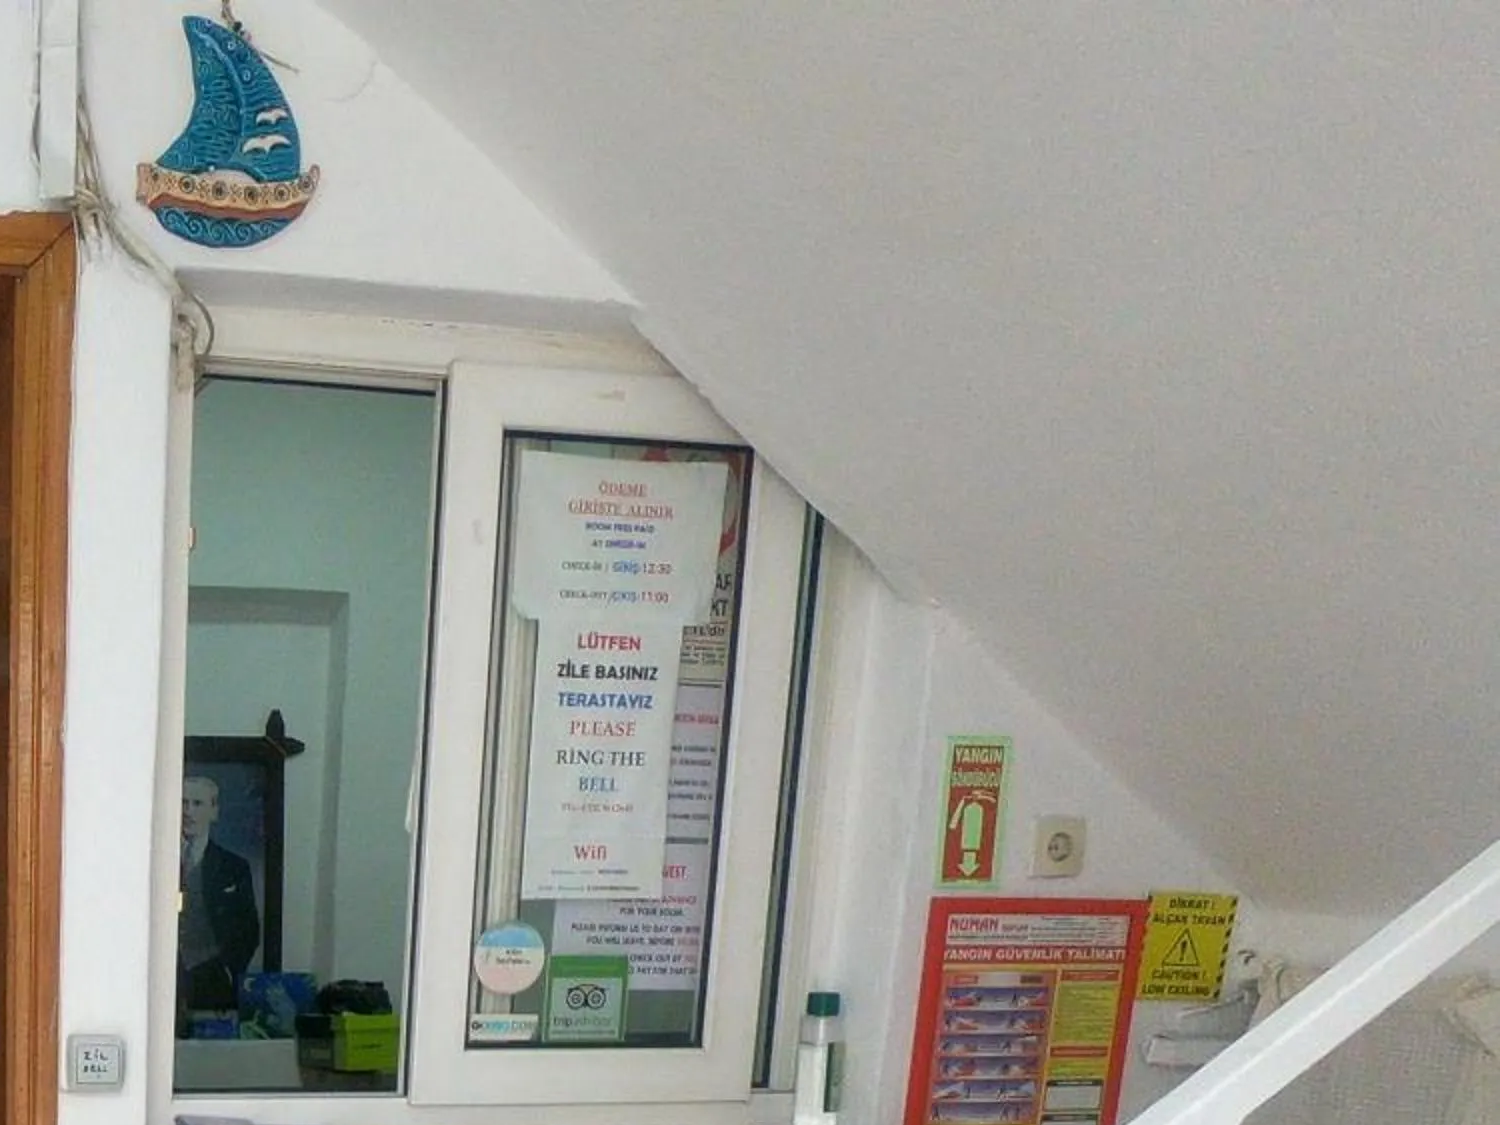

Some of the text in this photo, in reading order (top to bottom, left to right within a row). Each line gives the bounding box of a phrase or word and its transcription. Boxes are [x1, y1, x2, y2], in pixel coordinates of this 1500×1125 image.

[578, 632, 641, 651] LÜTFEN
[557, 659, 659, 681] ZİLE BASINIZ
[559, 692, 653, 709] TERASTAYIZ
[570, 720, 636, 737] PLEASE
[610, 752, 646, 767] THE
[579, 776, 618, 793] BELL
